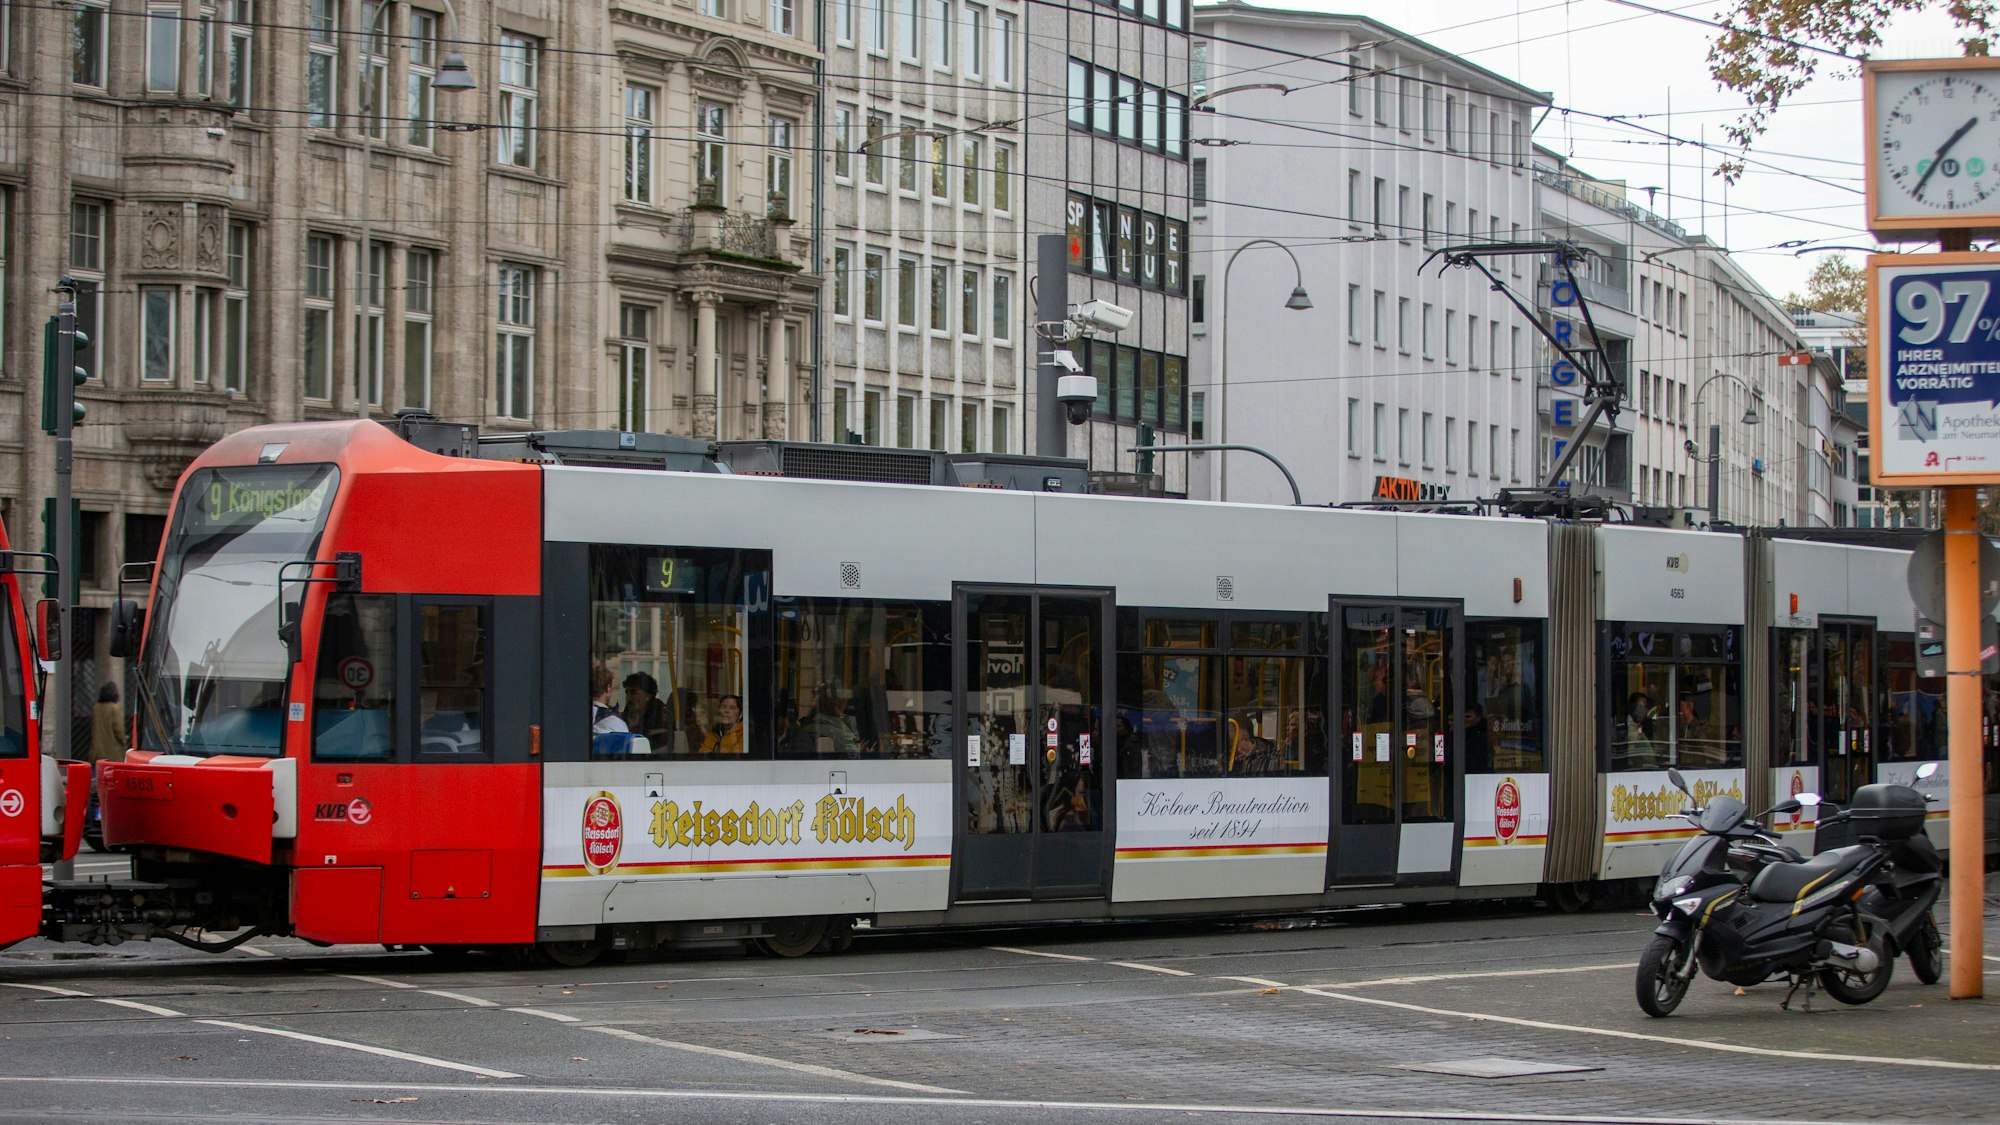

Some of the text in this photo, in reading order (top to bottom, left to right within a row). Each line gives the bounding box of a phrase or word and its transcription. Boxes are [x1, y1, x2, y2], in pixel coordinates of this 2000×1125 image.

[1942, 88, 1954, 99] 12
[1918, 96, 1930, 106] 11
[1900, 114, 1912, 125] 10
[1990, 112, 1997, 122] 2
[1893, 140, 1900, 151] 9
[1902, 166, 1909, 176] 8
[1974, 182, 1981, 193] 5
[1946, 190, 1954, 200] 6
[1897, 349, 1943, 361] IHRER
[1896, 375, 1974, 390] VORRÄTIG
[210, 482, 222, 520] 9
[1667, 556, 1680, 568] KVB
[660, 557, 674, 588] 9
[1670, 588, 1685, 599] 4563
[124, 777, 154, 792] 4563
[1137, 789, 1311, 817] Kölner Brautradition
[314, 803, 347, 819] KVB
[648, 793, 916, 851] Reissdorf Kölsch
[585, 826, 620, 840] Reissdorf
[1189, 819, 1262, 840] seit 1894
[590, 841, 614, 855] Kölsch
